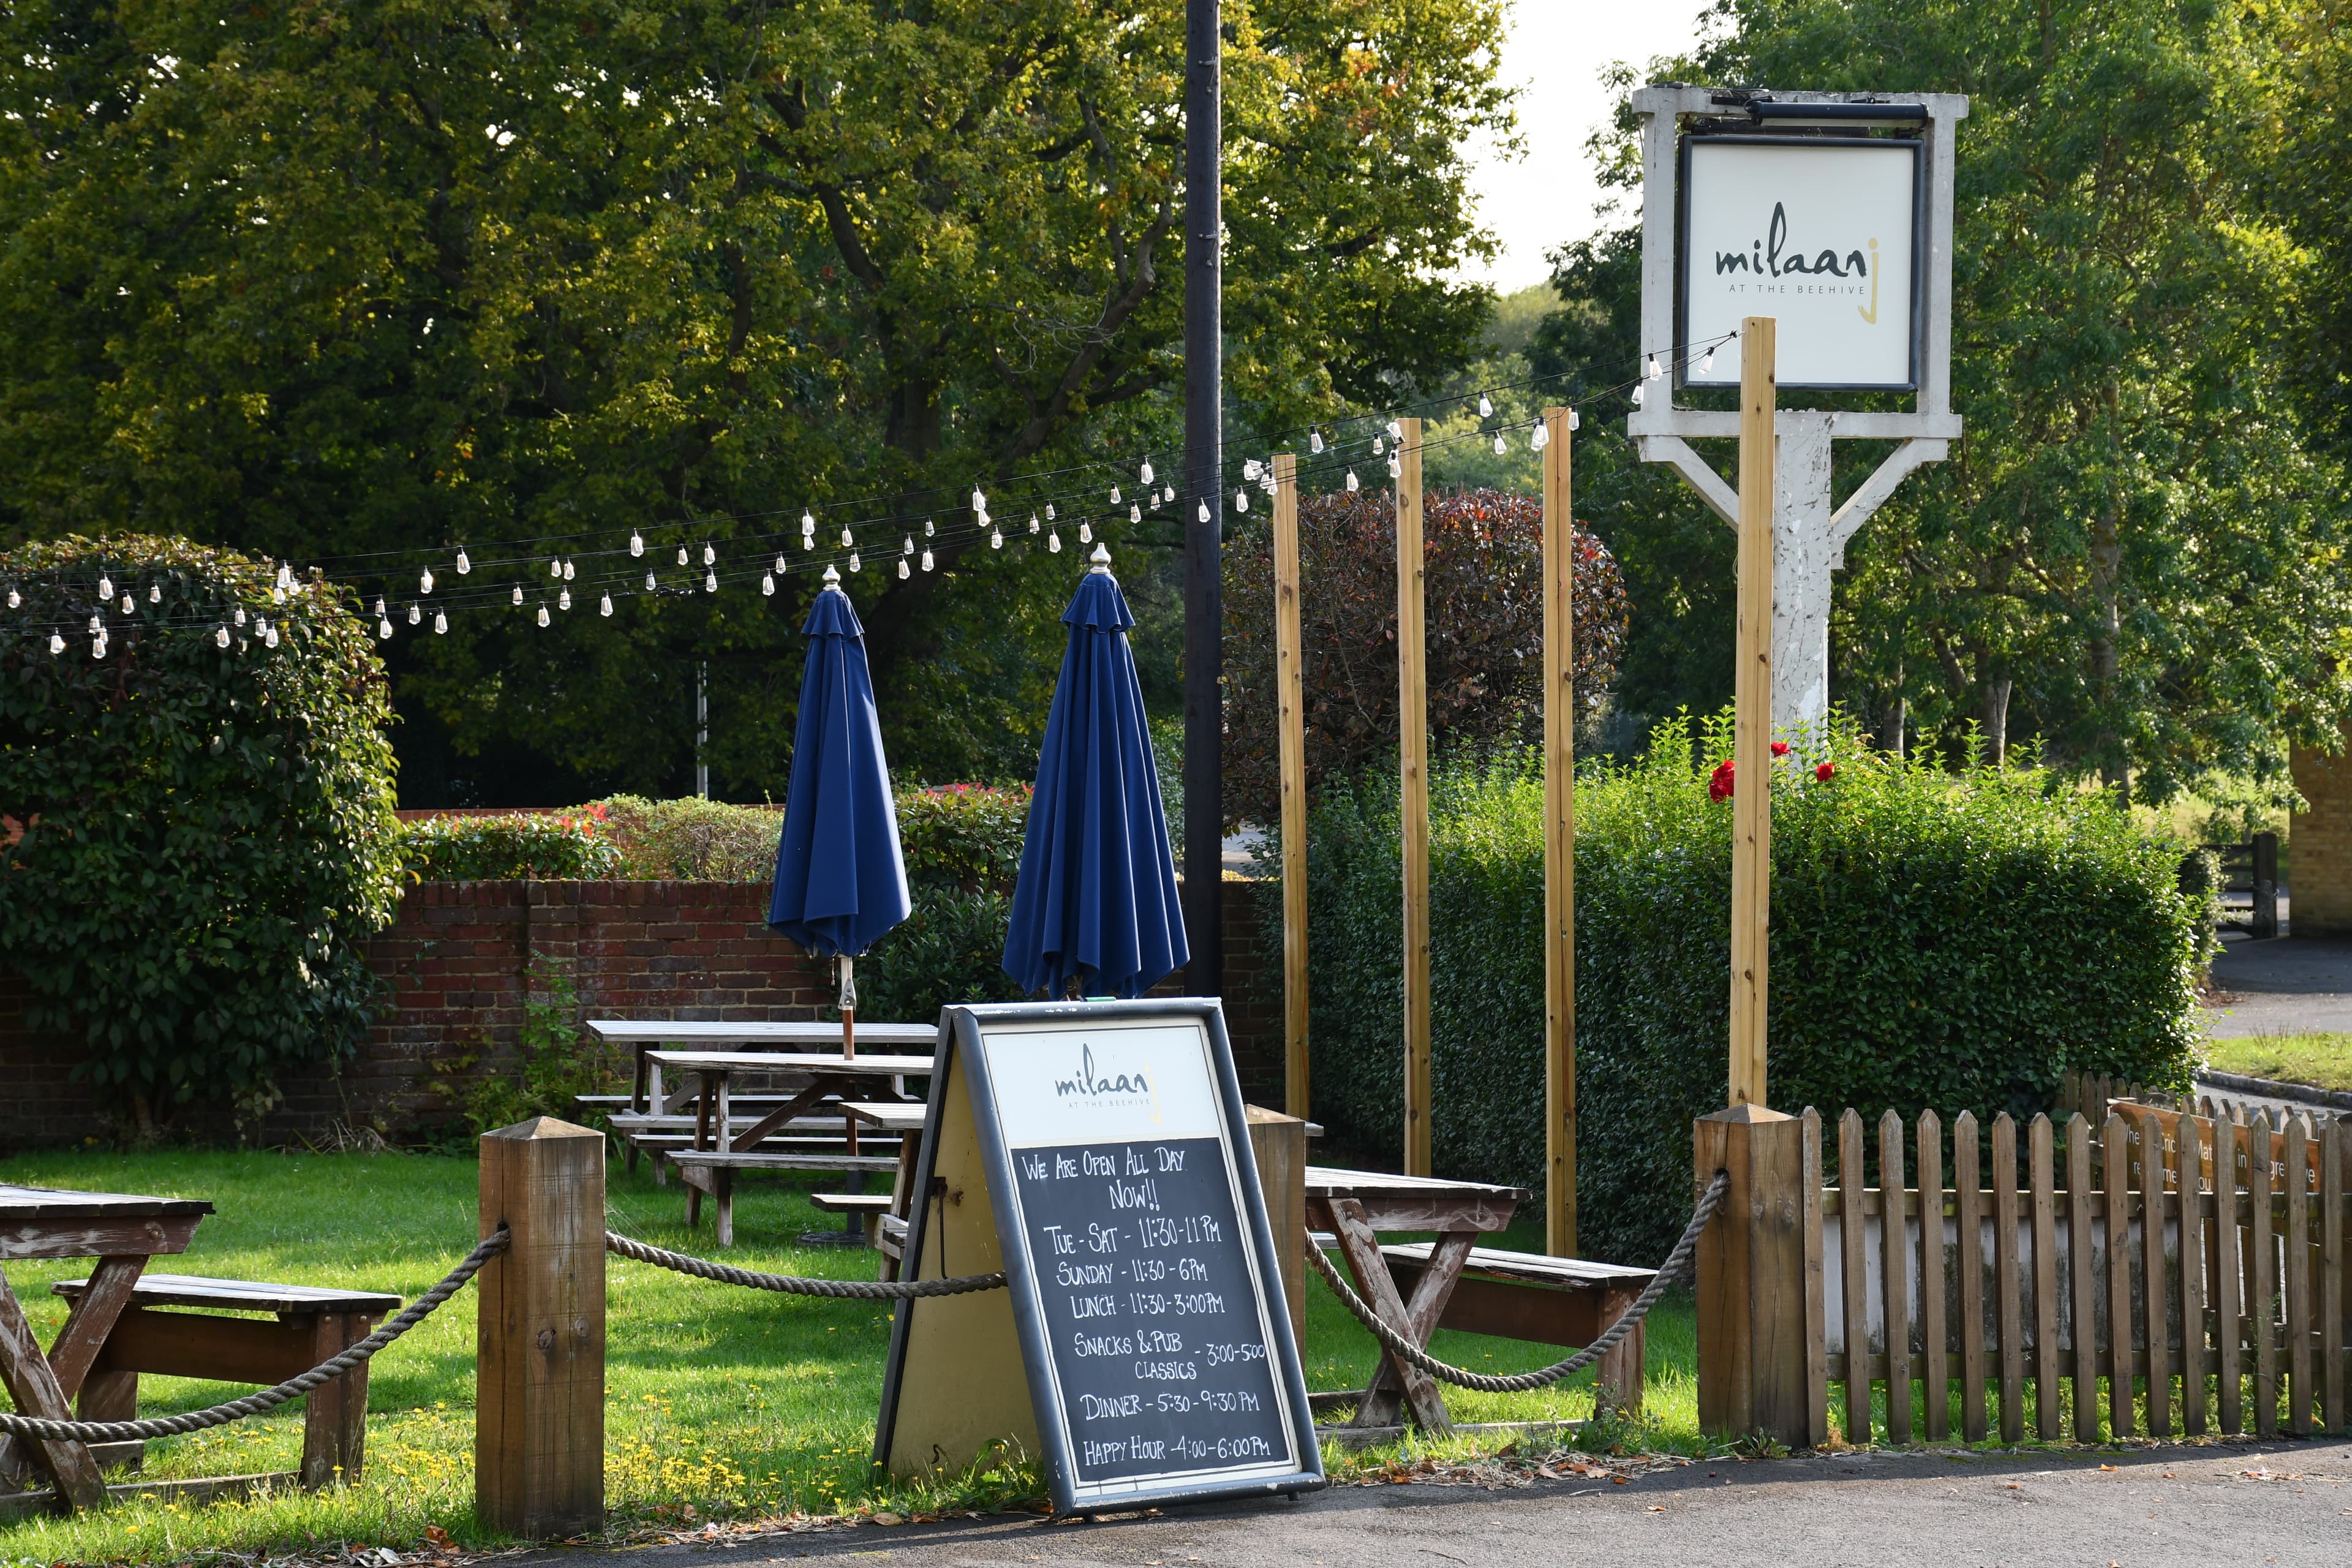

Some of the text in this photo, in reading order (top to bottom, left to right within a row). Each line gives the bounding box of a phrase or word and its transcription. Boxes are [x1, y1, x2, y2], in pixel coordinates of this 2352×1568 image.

[1729, 284, 1865, 295] AT THE BEEHIVE
[1109, 1098, 1152, 1107] BEEHIVE
[1083, 1150, 1116, 1176] OPEN
[1126, 1146, 1150, 1176] ALL
[1154, 1147, 1186, 1172] DAY
[1109, 1178, 1160, 1212] NOW!!
[1055, 1261, 1114, 1286] SUNDAY
[1069, 1294, 1117, 1319] LUNCH
[1074, 1332, 1133, 1357] SNACKS
[1135, 1361, 1197, 1381] CLASSICS
[1079, 1393, 1142, 1421] DINNER
[1083, 1440, 1128, 1466] HAPPY
[1130, 1434, 1166, 1460] HOUR
